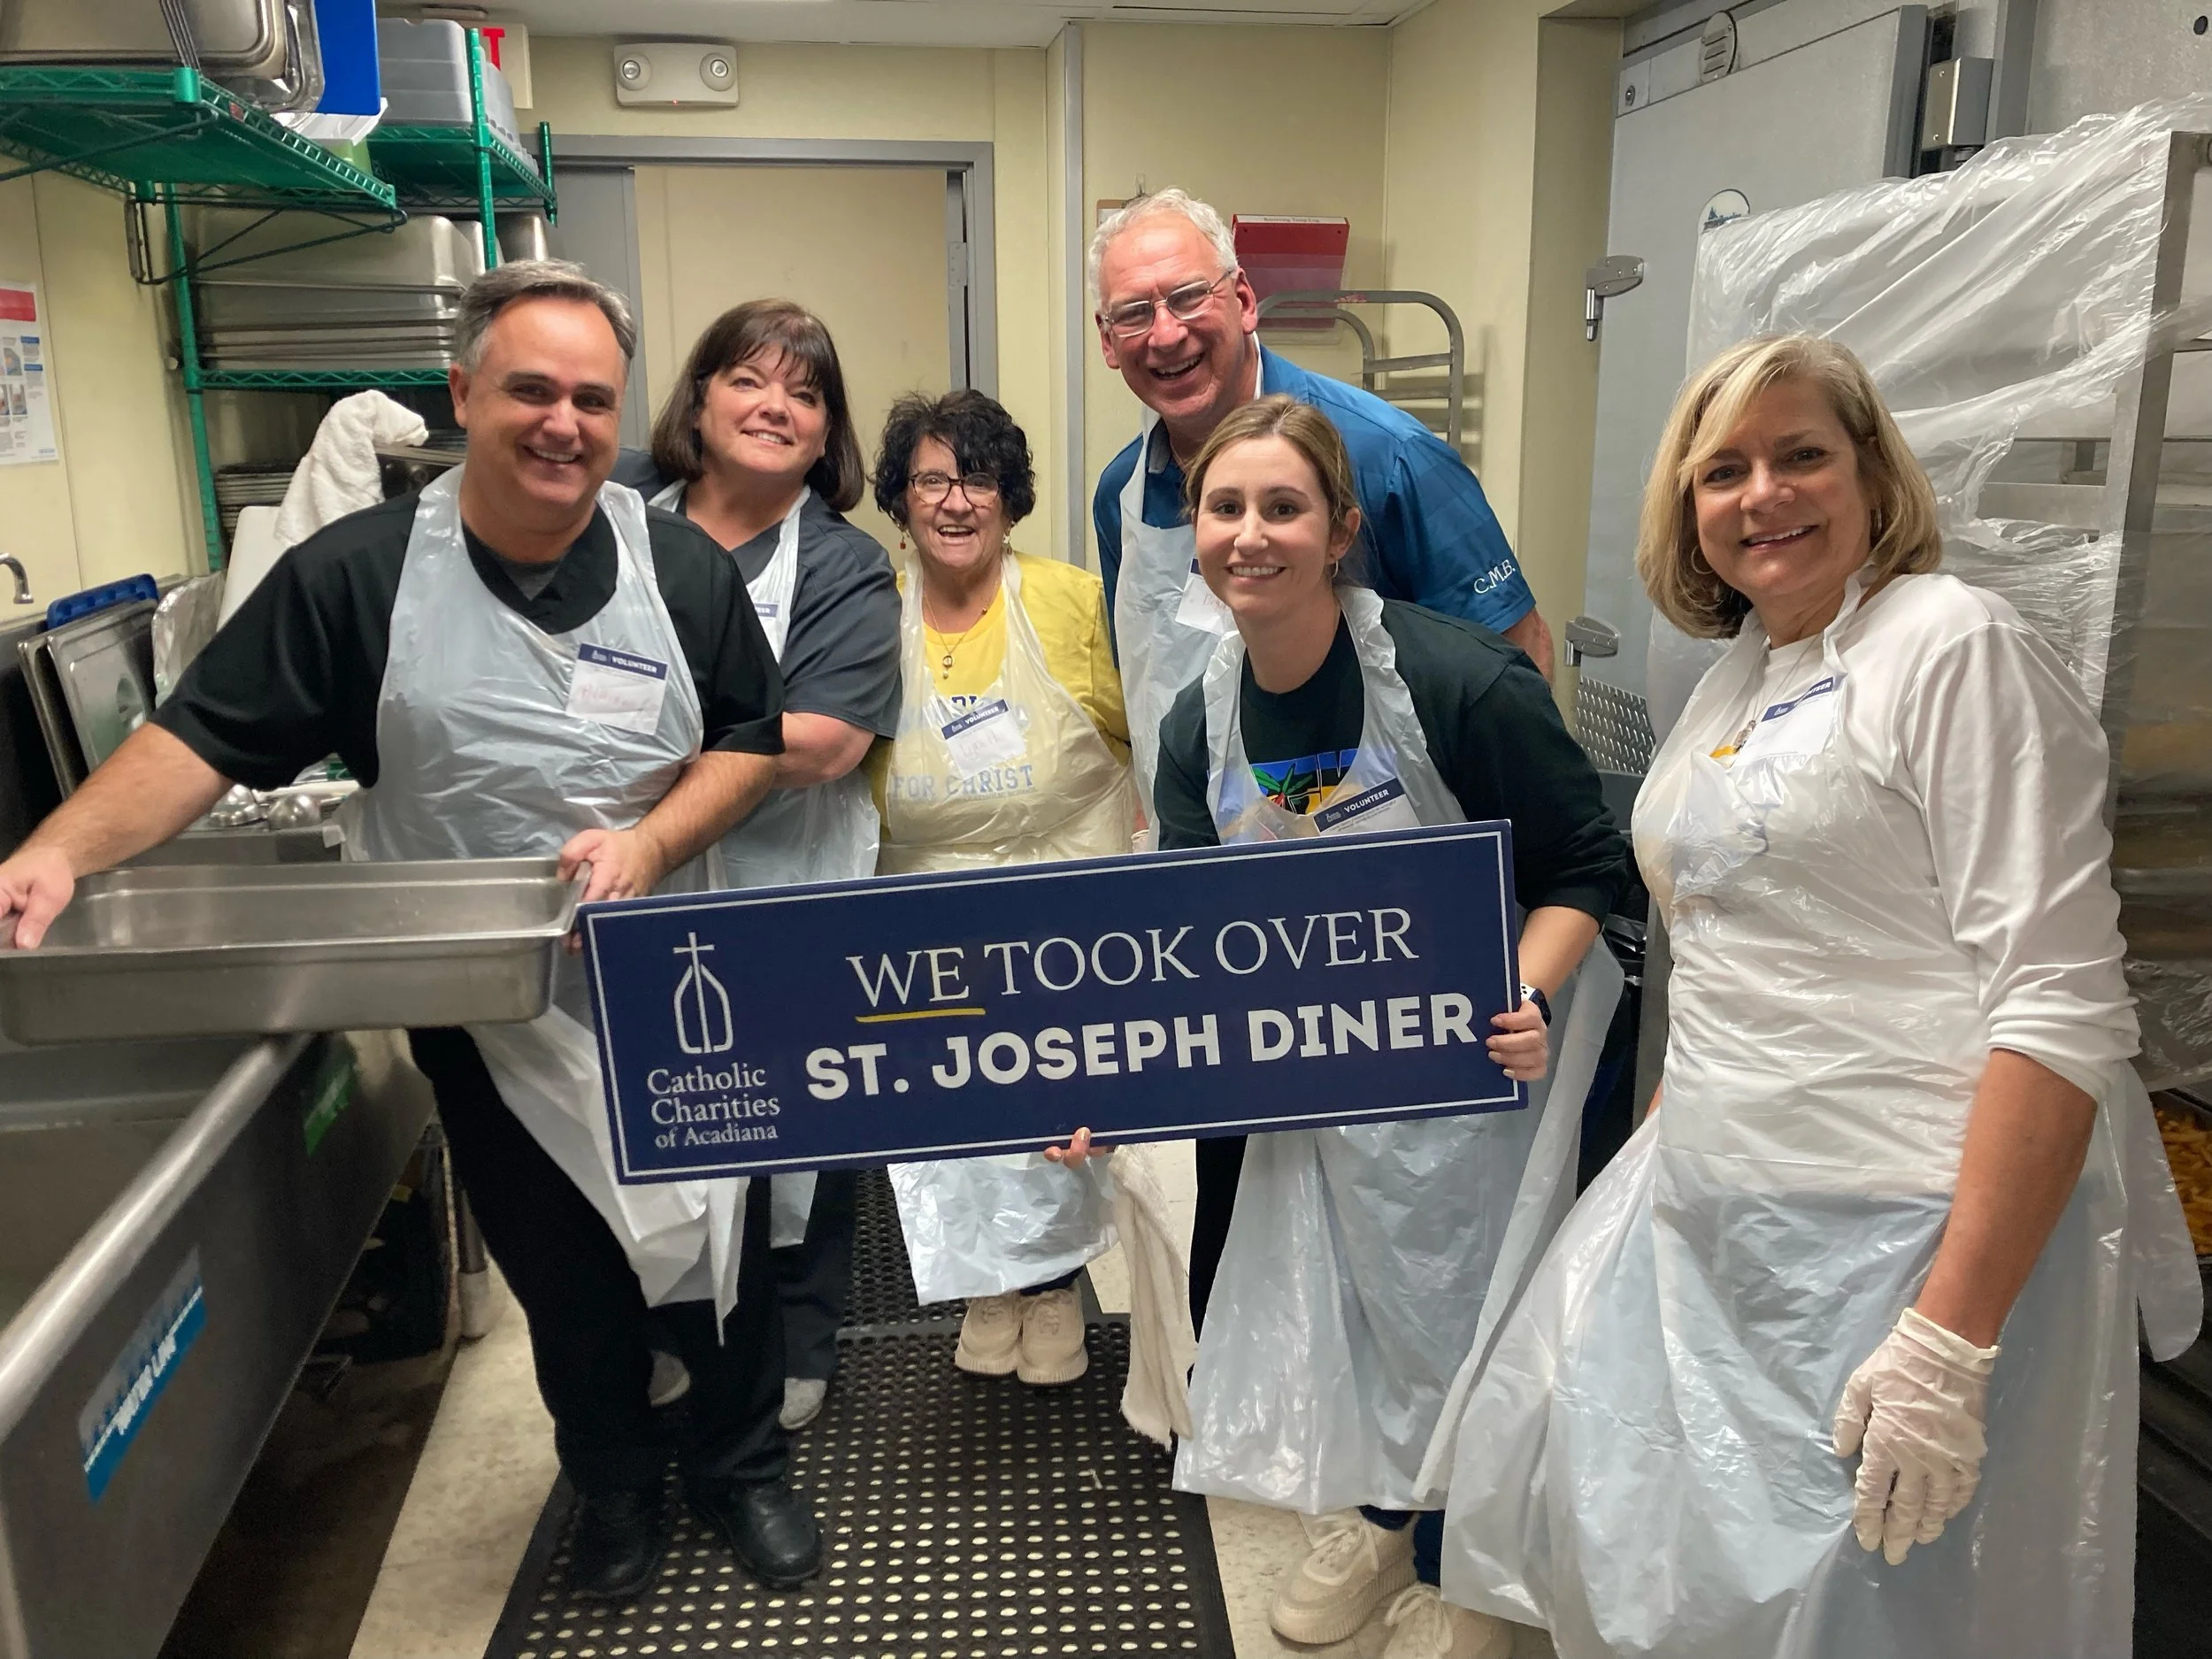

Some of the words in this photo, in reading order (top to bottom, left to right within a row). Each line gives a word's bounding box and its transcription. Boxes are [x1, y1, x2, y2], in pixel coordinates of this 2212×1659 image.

[1474, 559, 1515, 593] C.M.B.
[611, 656, 657, 673] VOLUNTEER
[964, 706, 999, 725] VOLUNTEER
[892, 775, 935, 798] FOR
[947, 764, 1033, 795] CHRIST
[1344, 789, 1390, 812] VOLUNTEER
[845, 947, 970, 1008] WE
[984, 926, 1200, 995] TOOK
[1215, 907, 1419, 975] OVER
[805, 1043, 910, 1101] ST.
[932, 1014, 1221, 1090] JOSEPH
[1248, 992, 1478, 1063] DINER
[647, 1062, 766, 1095] Catholic
[651, 1094, 780, 1125] Charities
[655, 1126, 679, 1148] of
[684, 1123, 779, 1147] Acadiana
